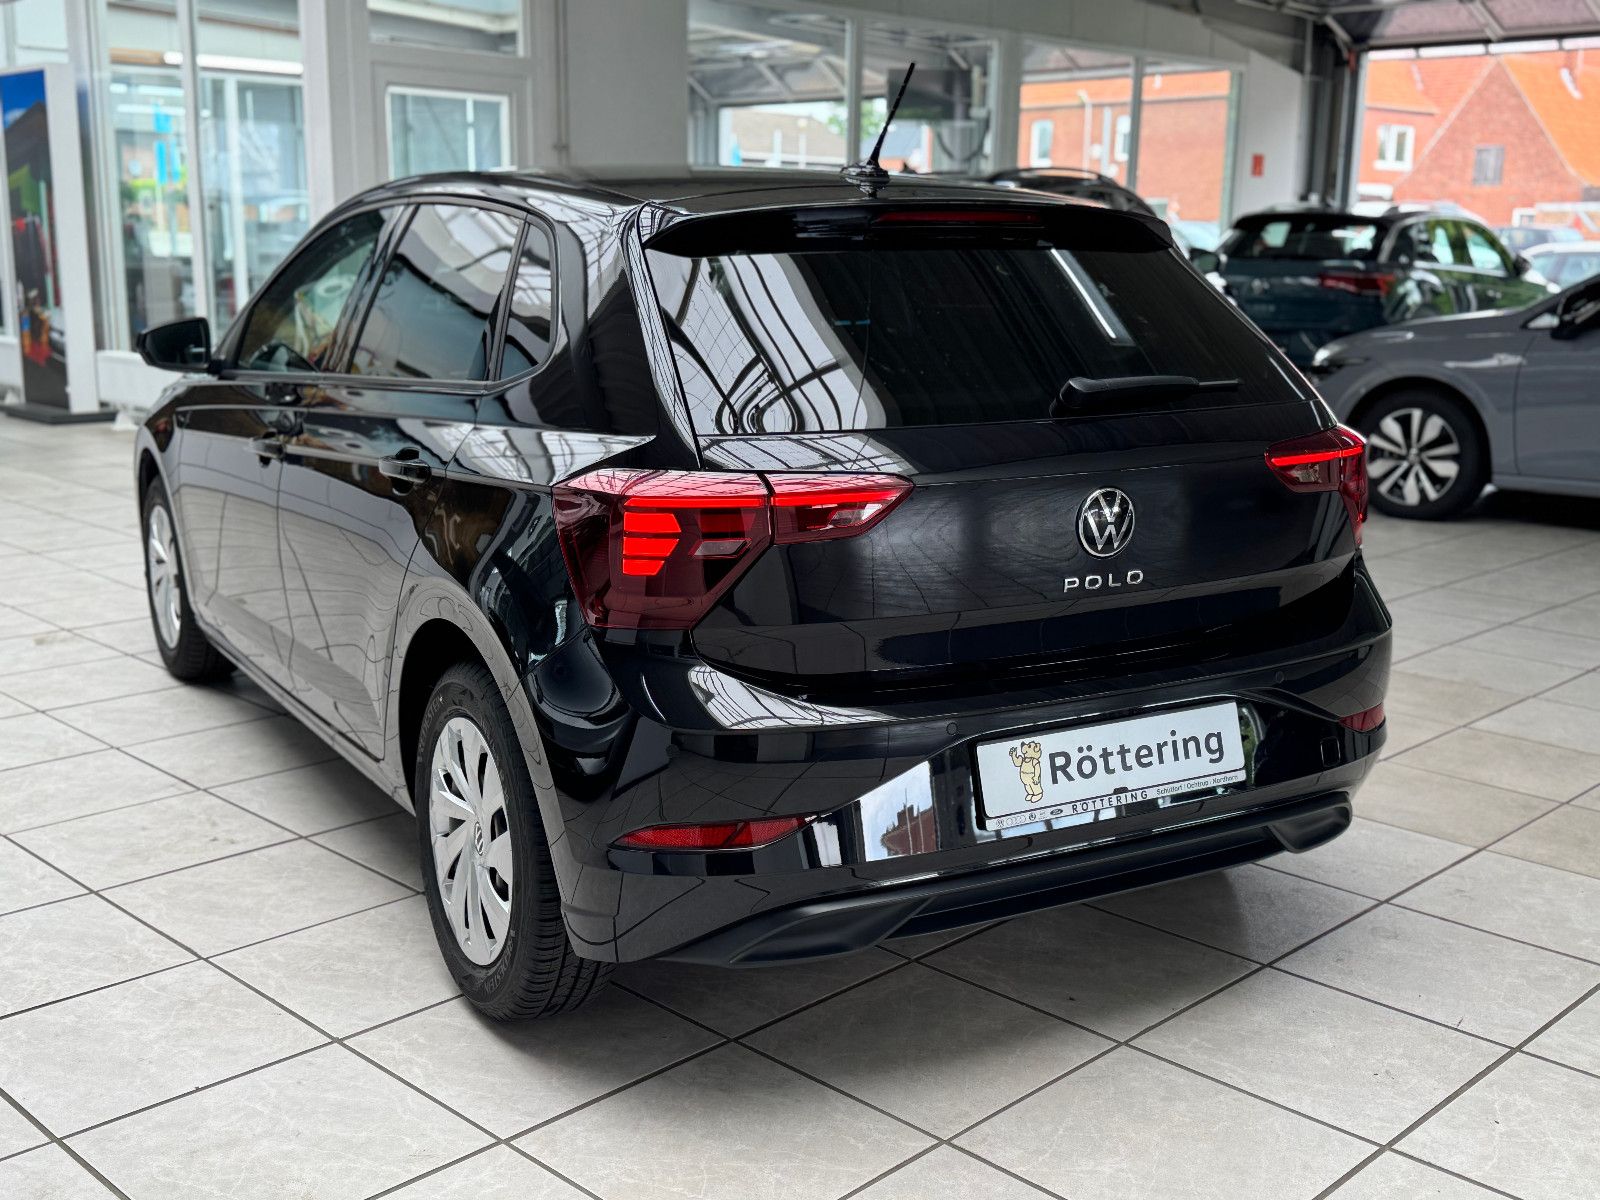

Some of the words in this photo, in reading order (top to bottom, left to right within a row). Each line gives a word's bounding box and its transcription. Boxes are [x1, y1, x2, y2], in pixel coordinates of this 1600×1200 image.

[1063, 570, 1144, 593] POLO
[1049, 729, 1225, 785] Röttering
[1072, 790, 1148, 814] RÖTTERING
